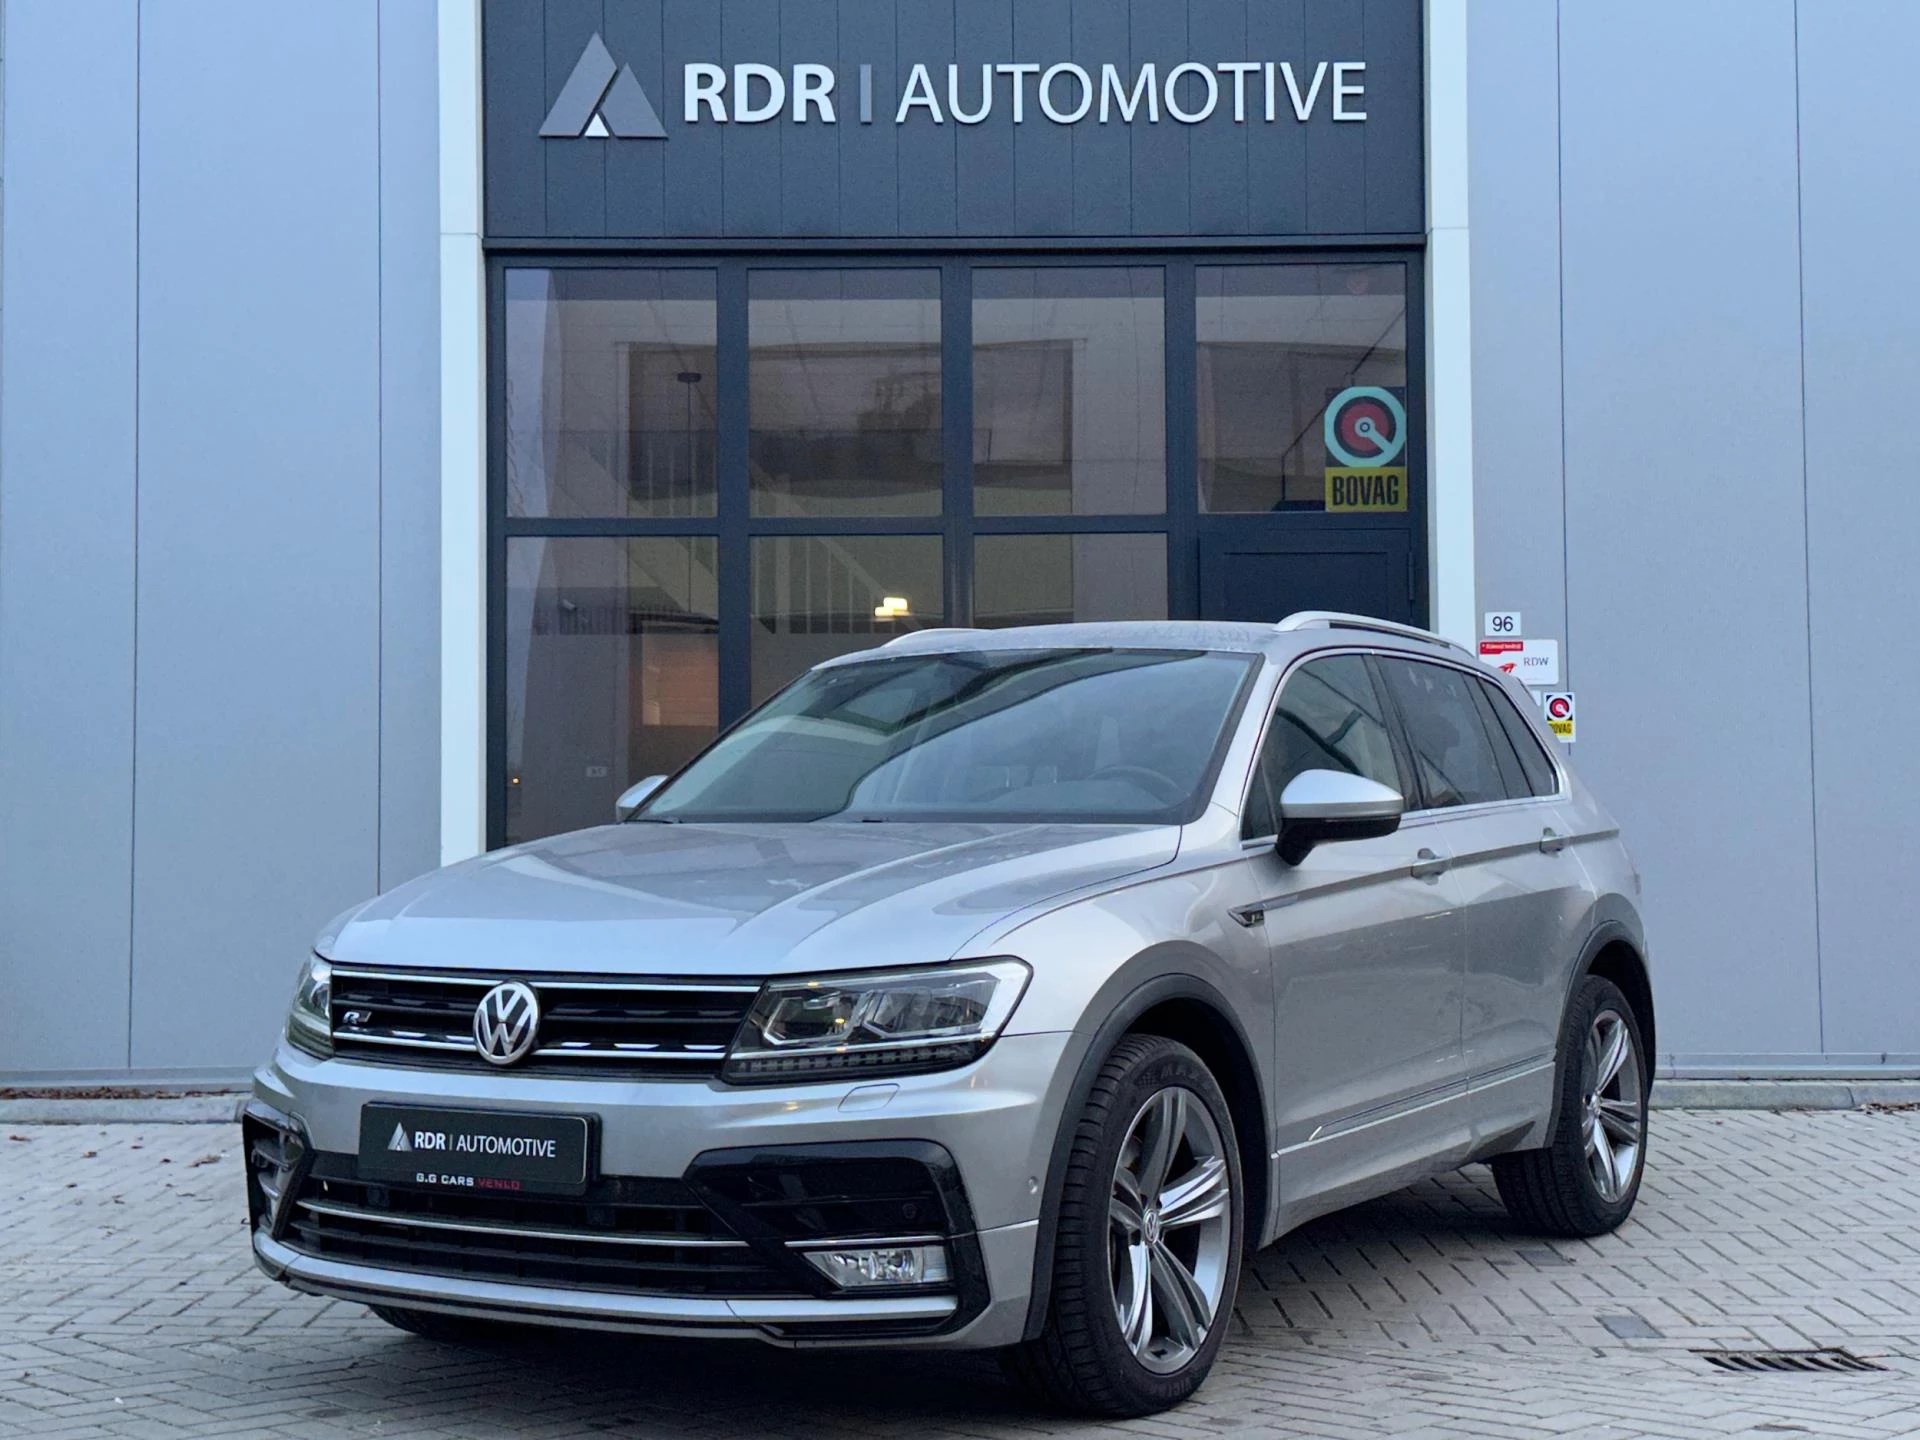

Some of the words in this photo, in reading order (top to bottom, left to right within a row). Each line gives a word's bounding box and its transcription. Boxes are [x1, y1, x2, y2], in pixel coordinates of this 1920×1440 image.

[683, 62, 836, 124] RDR
[895, 60, 1368, 125] AUTOMOTIVE
[1332, 474, 1399, 506] BOVAG
[1492, 615, 1514, 632] 96
[1523, 657, 1549, 666] RDW
[1549, 723, 1572, 734] OVAG
[414, 1131, 446, 1150] RDR
[455, 1134, 557, 1158] AUTOMOTIVE
[415, 1172, 437, 1184] G.G
[440, 1173, 475, 1187] CARS
[477, 1178, 522, 1191] VENLO
